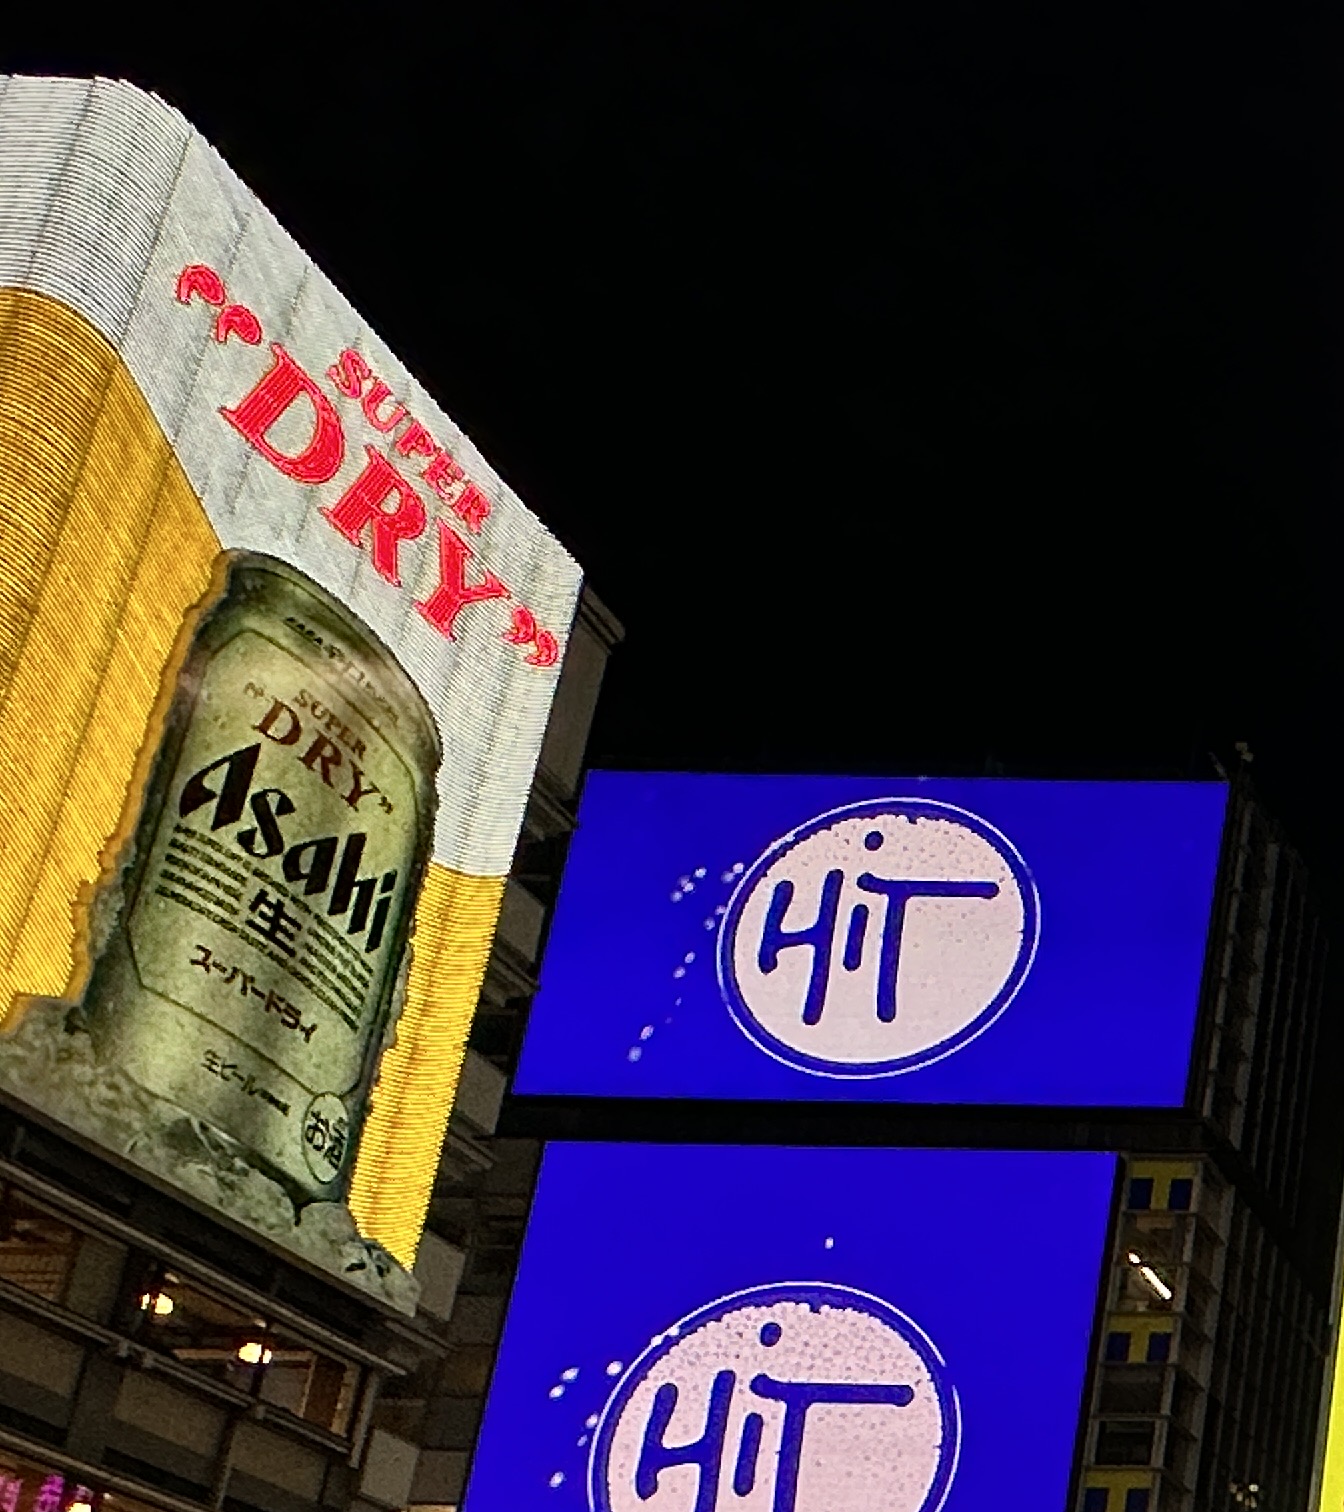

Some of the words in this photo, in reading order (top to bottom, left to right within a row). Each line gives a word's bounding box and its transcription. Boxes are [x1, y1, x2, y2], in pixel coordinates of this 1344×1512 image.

[327, 347, 493, 535] SUPER
[293, 688, 368, 761] SUPER
[178, 741, 397, 954] Asahi
[244, 888, 303, 959] 生
[189, 944, 318, 1044] スーパードライ
